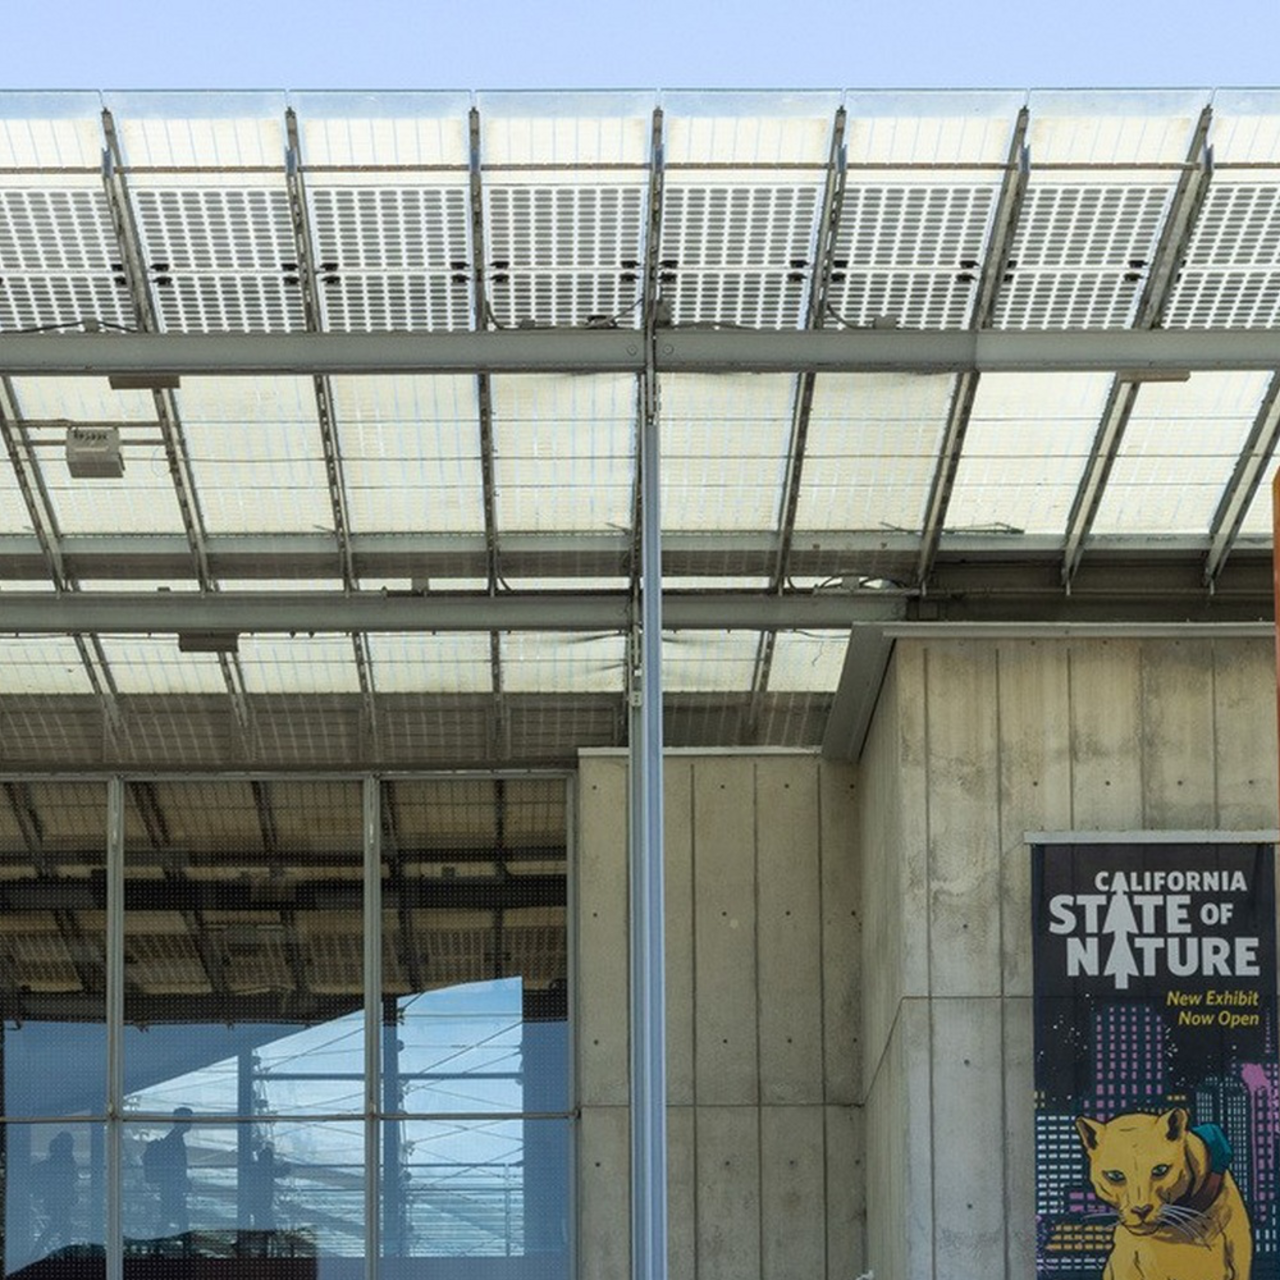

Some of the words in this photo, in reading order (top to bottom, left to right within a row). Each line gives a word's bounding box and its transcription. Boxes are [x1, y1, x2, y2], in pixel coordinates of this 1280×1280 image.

[1094, 871, 1247, 892] CALIFORNIA
[1049, 894, 1192, 934] STATE
[1200, 903, 1233, 925] OF
[1067, 937, 1260, 977] NATURE
[1166, 991, 1202, 1006] New
[1206, 991, 1259, 1006] Exhibit
[1179, 1011, 1214, 1025] Now
[1218, 1011, 1259, 1028] Open
